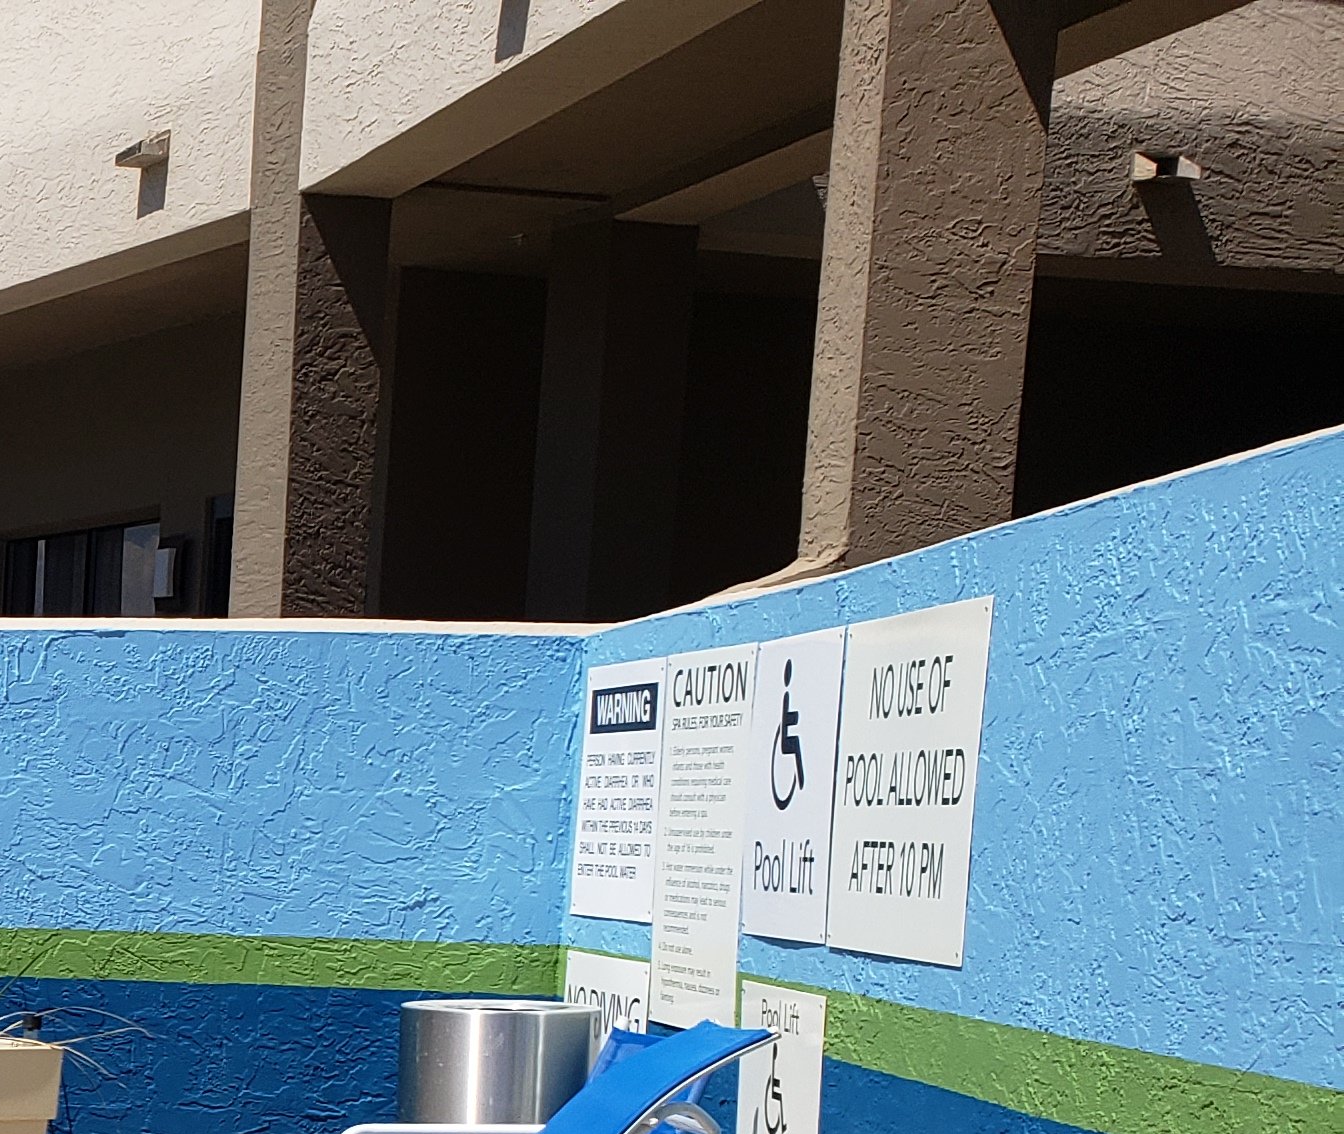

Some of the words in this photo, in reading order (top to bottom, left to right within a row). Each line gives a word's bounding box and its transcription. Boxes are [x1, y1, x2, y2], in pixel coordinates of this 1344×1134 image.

[597, 689, 651, 726] WARNING
[673, 661, 749, 707] CAUTION
[869, 665, 895, 720] NO
[897, 659, 926, 718] USE
[928, 655, 954, 714] OF
[843, 753, 884, 807] POOL
[886, 748, 966, 807] ALLOWED
[753, 838, 786, 893] Pool
[789, 839, 815, 895] Lift
[848, 840, 895, 895] AFTER
[899, 841, 915, 897] 10
[917, 842, 945, 899] PM
[762, 998, 781, 1030] Pool
[783, 1003, 800, 1035] Lift
